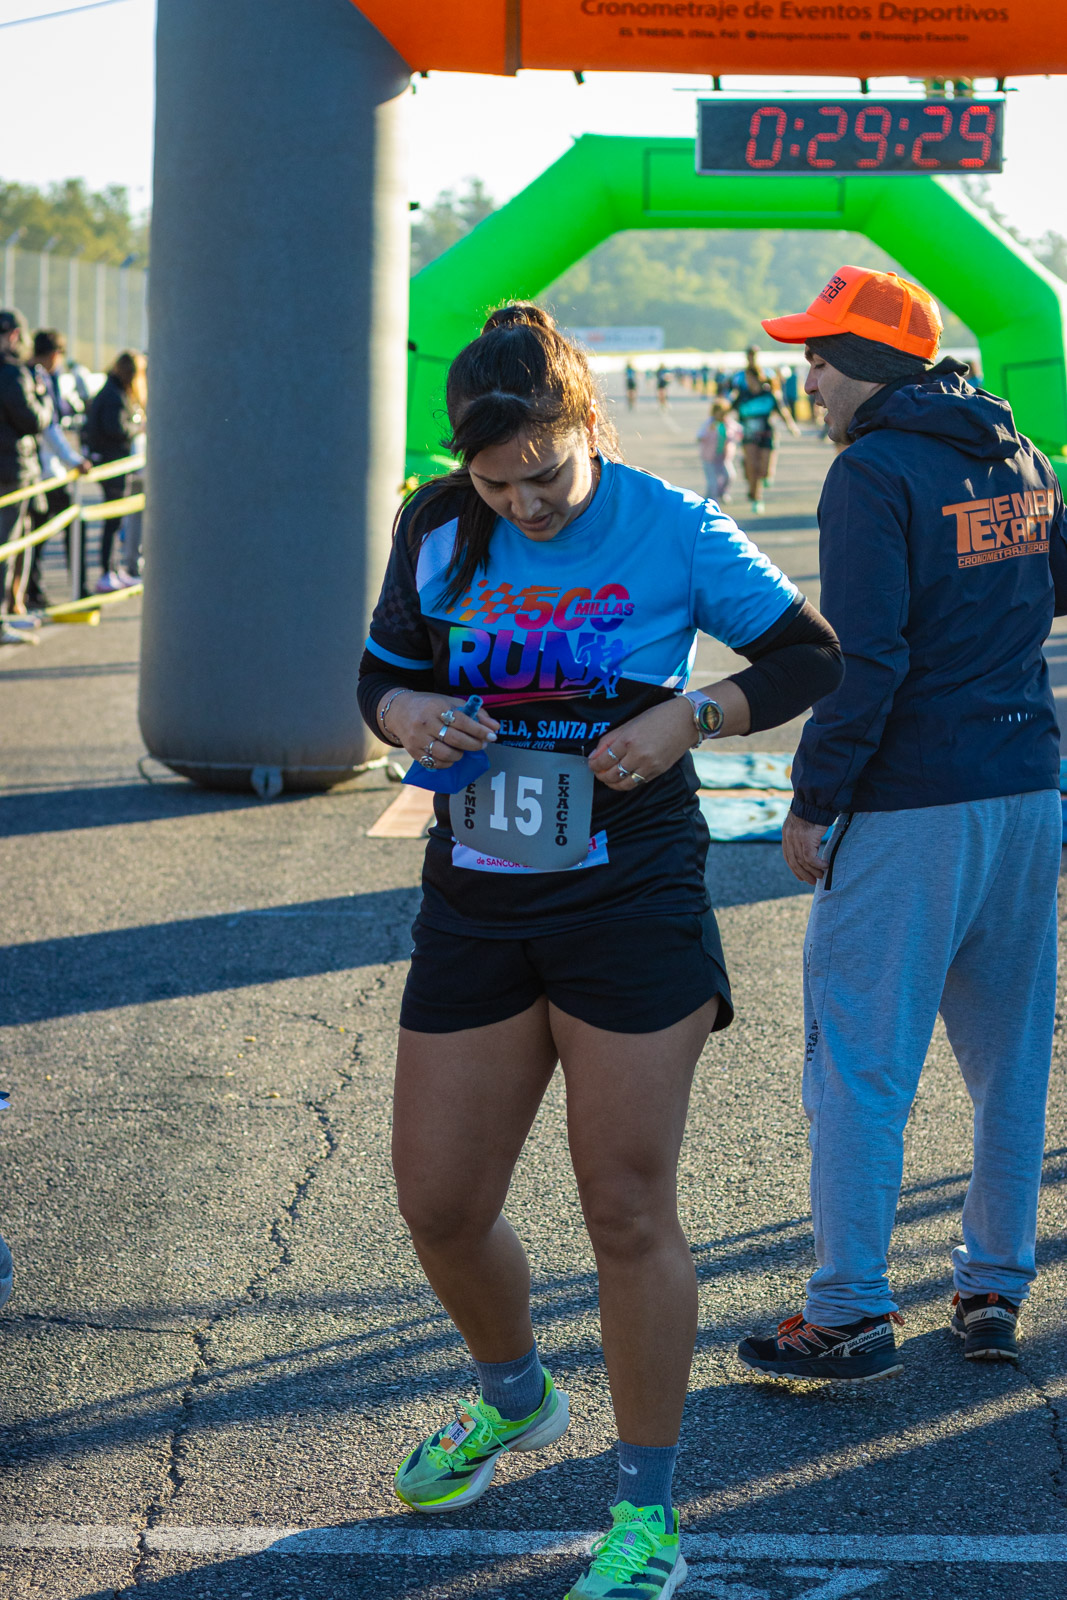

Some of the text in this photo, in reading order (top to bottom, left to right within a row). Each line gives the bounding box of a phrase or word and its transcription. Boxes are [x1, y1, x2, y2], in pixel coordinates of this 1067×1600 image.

[580, 0, 1009, 23] Cronometraje de Eventos Deportivos
[745, 106, 996, 168] 0:29:29
[574, 602, 635, 616] MILLAS
[449, 626, 601, 690] RUN
[495, 719, 532, 739] ELA,
[536, 720, 587, 739] SANTA
[489, 771, 543, 836] 15
[554, 773, 570, 847] EXACTO
[476, 856, 485, 865] de
